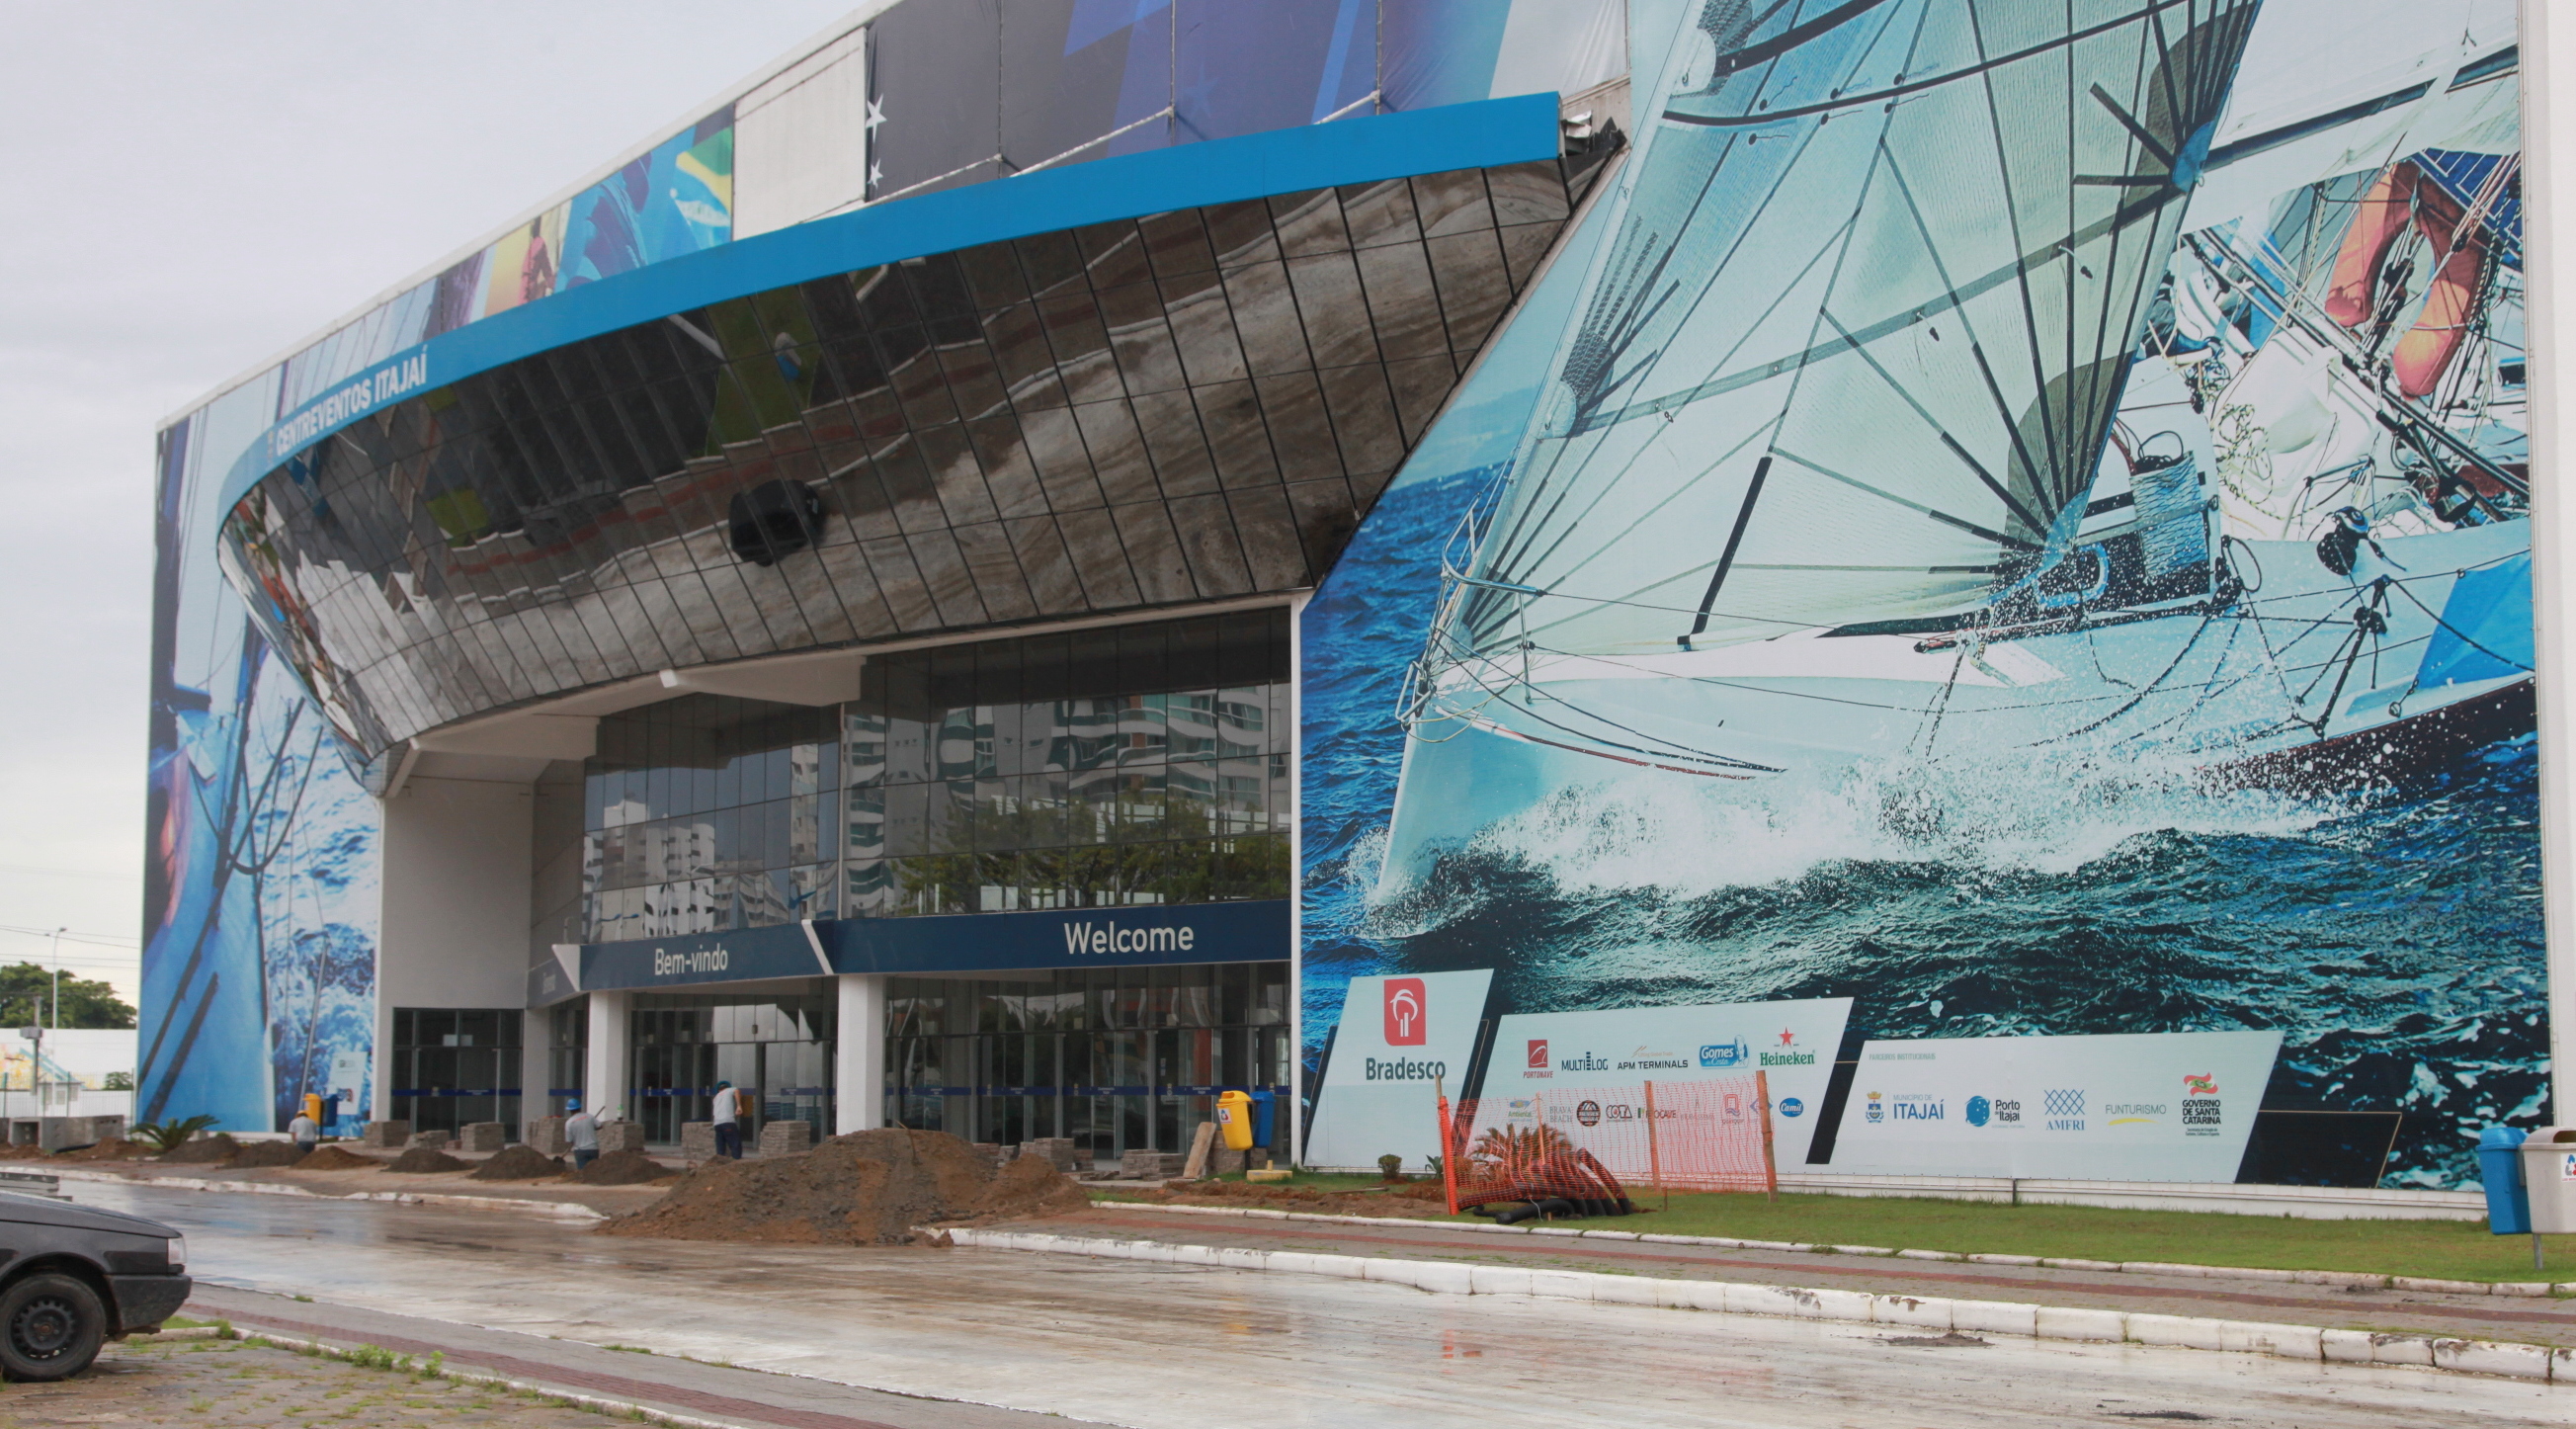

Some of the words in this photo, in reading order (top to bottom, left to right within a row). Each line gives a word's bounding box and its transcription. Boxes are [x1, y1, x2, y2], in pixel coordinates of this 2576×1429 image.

[276, 378, 372, 457] CENTREVENTOS
[374, 344, 428, 403] ITAJAÍ
[1064, 920, 1195, 955] Welcome
[654, 942, 728, 975] Bem-vindo
[1701, 1047, 1734, 1060] Gomes
[1760, 1051, 1815, 1066] Heineken
[1366, 1056, 1447, 1080] Bradesco
[1618, 1061, 1635, 1070] APM
[1638, 1059, 1689, 1069] TERMINALS
[1781, 1102, 1803, 1112] Camil
[1893, 1099, 1945, 1120] ITAJAÍ
[1996, 1099, 2021, 1111] Porto
[2106, 1104, 2167, 1115] FUNTURISMO
[2182, 1099, 2221, 1108] GOVERNO
[2045, 1120, 2086, 1131] AMFRI
